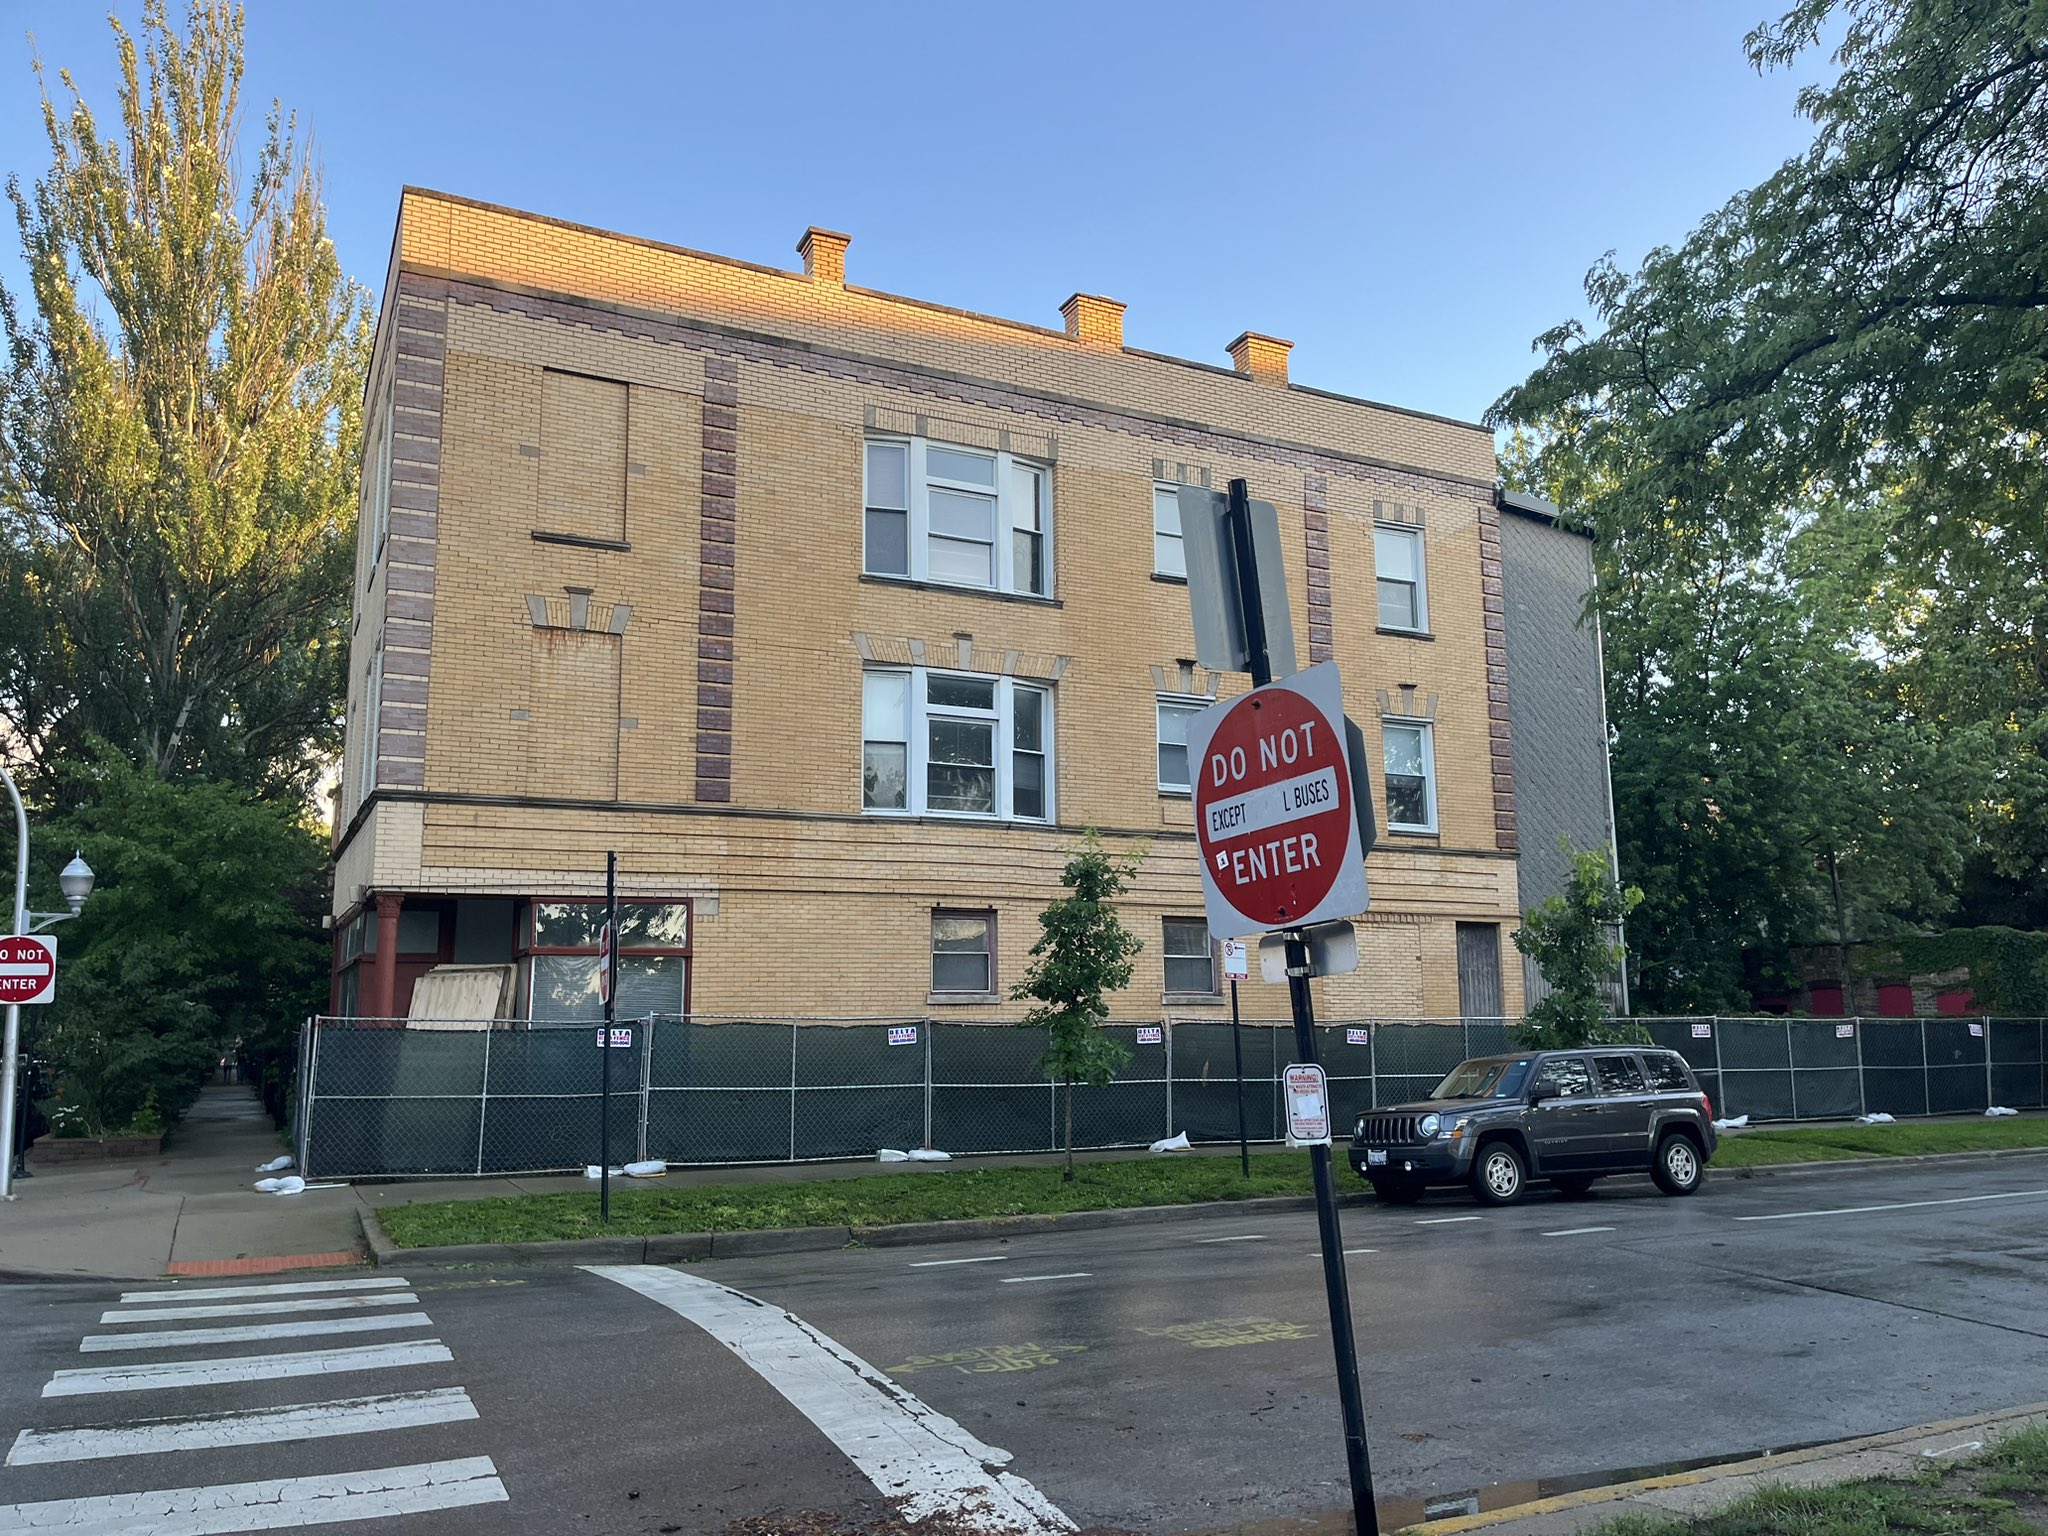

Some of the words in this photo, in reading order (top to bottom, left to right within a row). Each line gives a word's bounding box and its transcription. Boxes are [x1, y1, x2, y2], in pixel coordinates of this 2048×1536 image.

[1211, 746, 1247, 787] DO
[1258, 720, 1316, 772] NOT
[1212, 802, 1247, 832] EXCEPT
[1293, 778, 1330, 808] BUSES
[1232, 832, 1321, 885] ENTER
[17, 949, 44, 960] NOT
[0, 978, 37, 990] NTER
[1290, 1074, 1319, 1082] WARNING!
